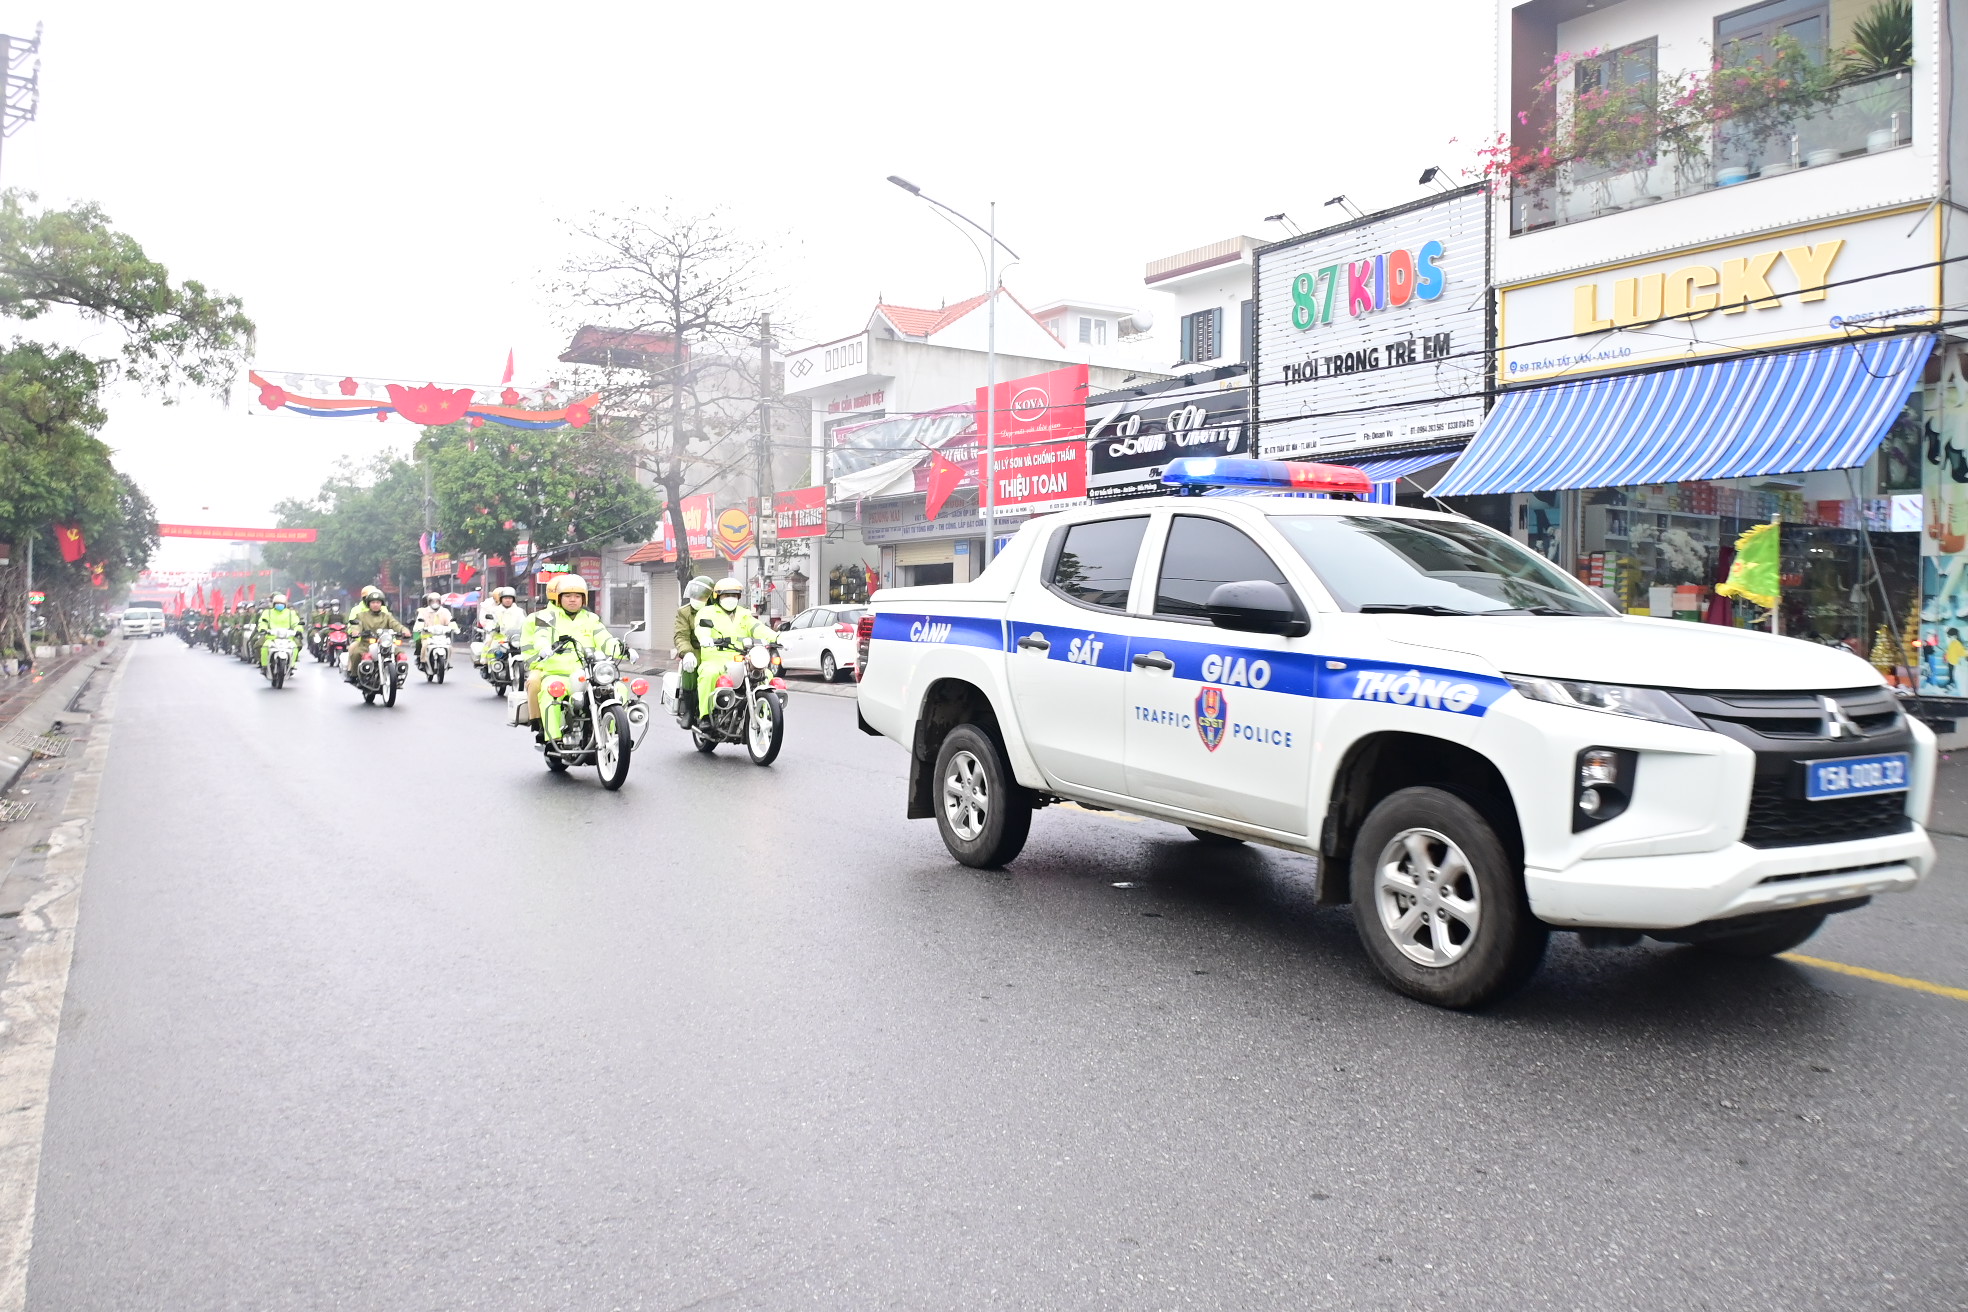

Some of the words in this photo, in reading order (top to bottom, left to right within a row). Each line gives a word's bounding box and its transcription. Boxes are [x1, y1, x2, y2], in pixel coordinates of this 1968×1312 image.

[1291, 264, 1341, 330] 87
[1348, 240, 1446, 318] KIDS
[1574, 239, 1846, 335] LUCKY
[1283, 354, 1319, 387] THỜI
[1326, 347, 1380, 376] TRANG
[1386, 332, 1416, 365] TRẺ
[1422, 332, 1451, 360] EM
[1015, 398, 1044, 411] KOVA
[1000, 473, 1030, 501] THIỆU
[1032, 472, 1068, 495] TOAN
[910, 615, 952, 643] CẢNH
[1068, 633, 1104, 667] SÁT
[1201, 653, 1271, 689] GIAO
[1352, 668, 1479, 712] THÔNG
[1135, 705, 1192, 730] TRAFFIC
[1234, 723, 1292, 749] POLICE
